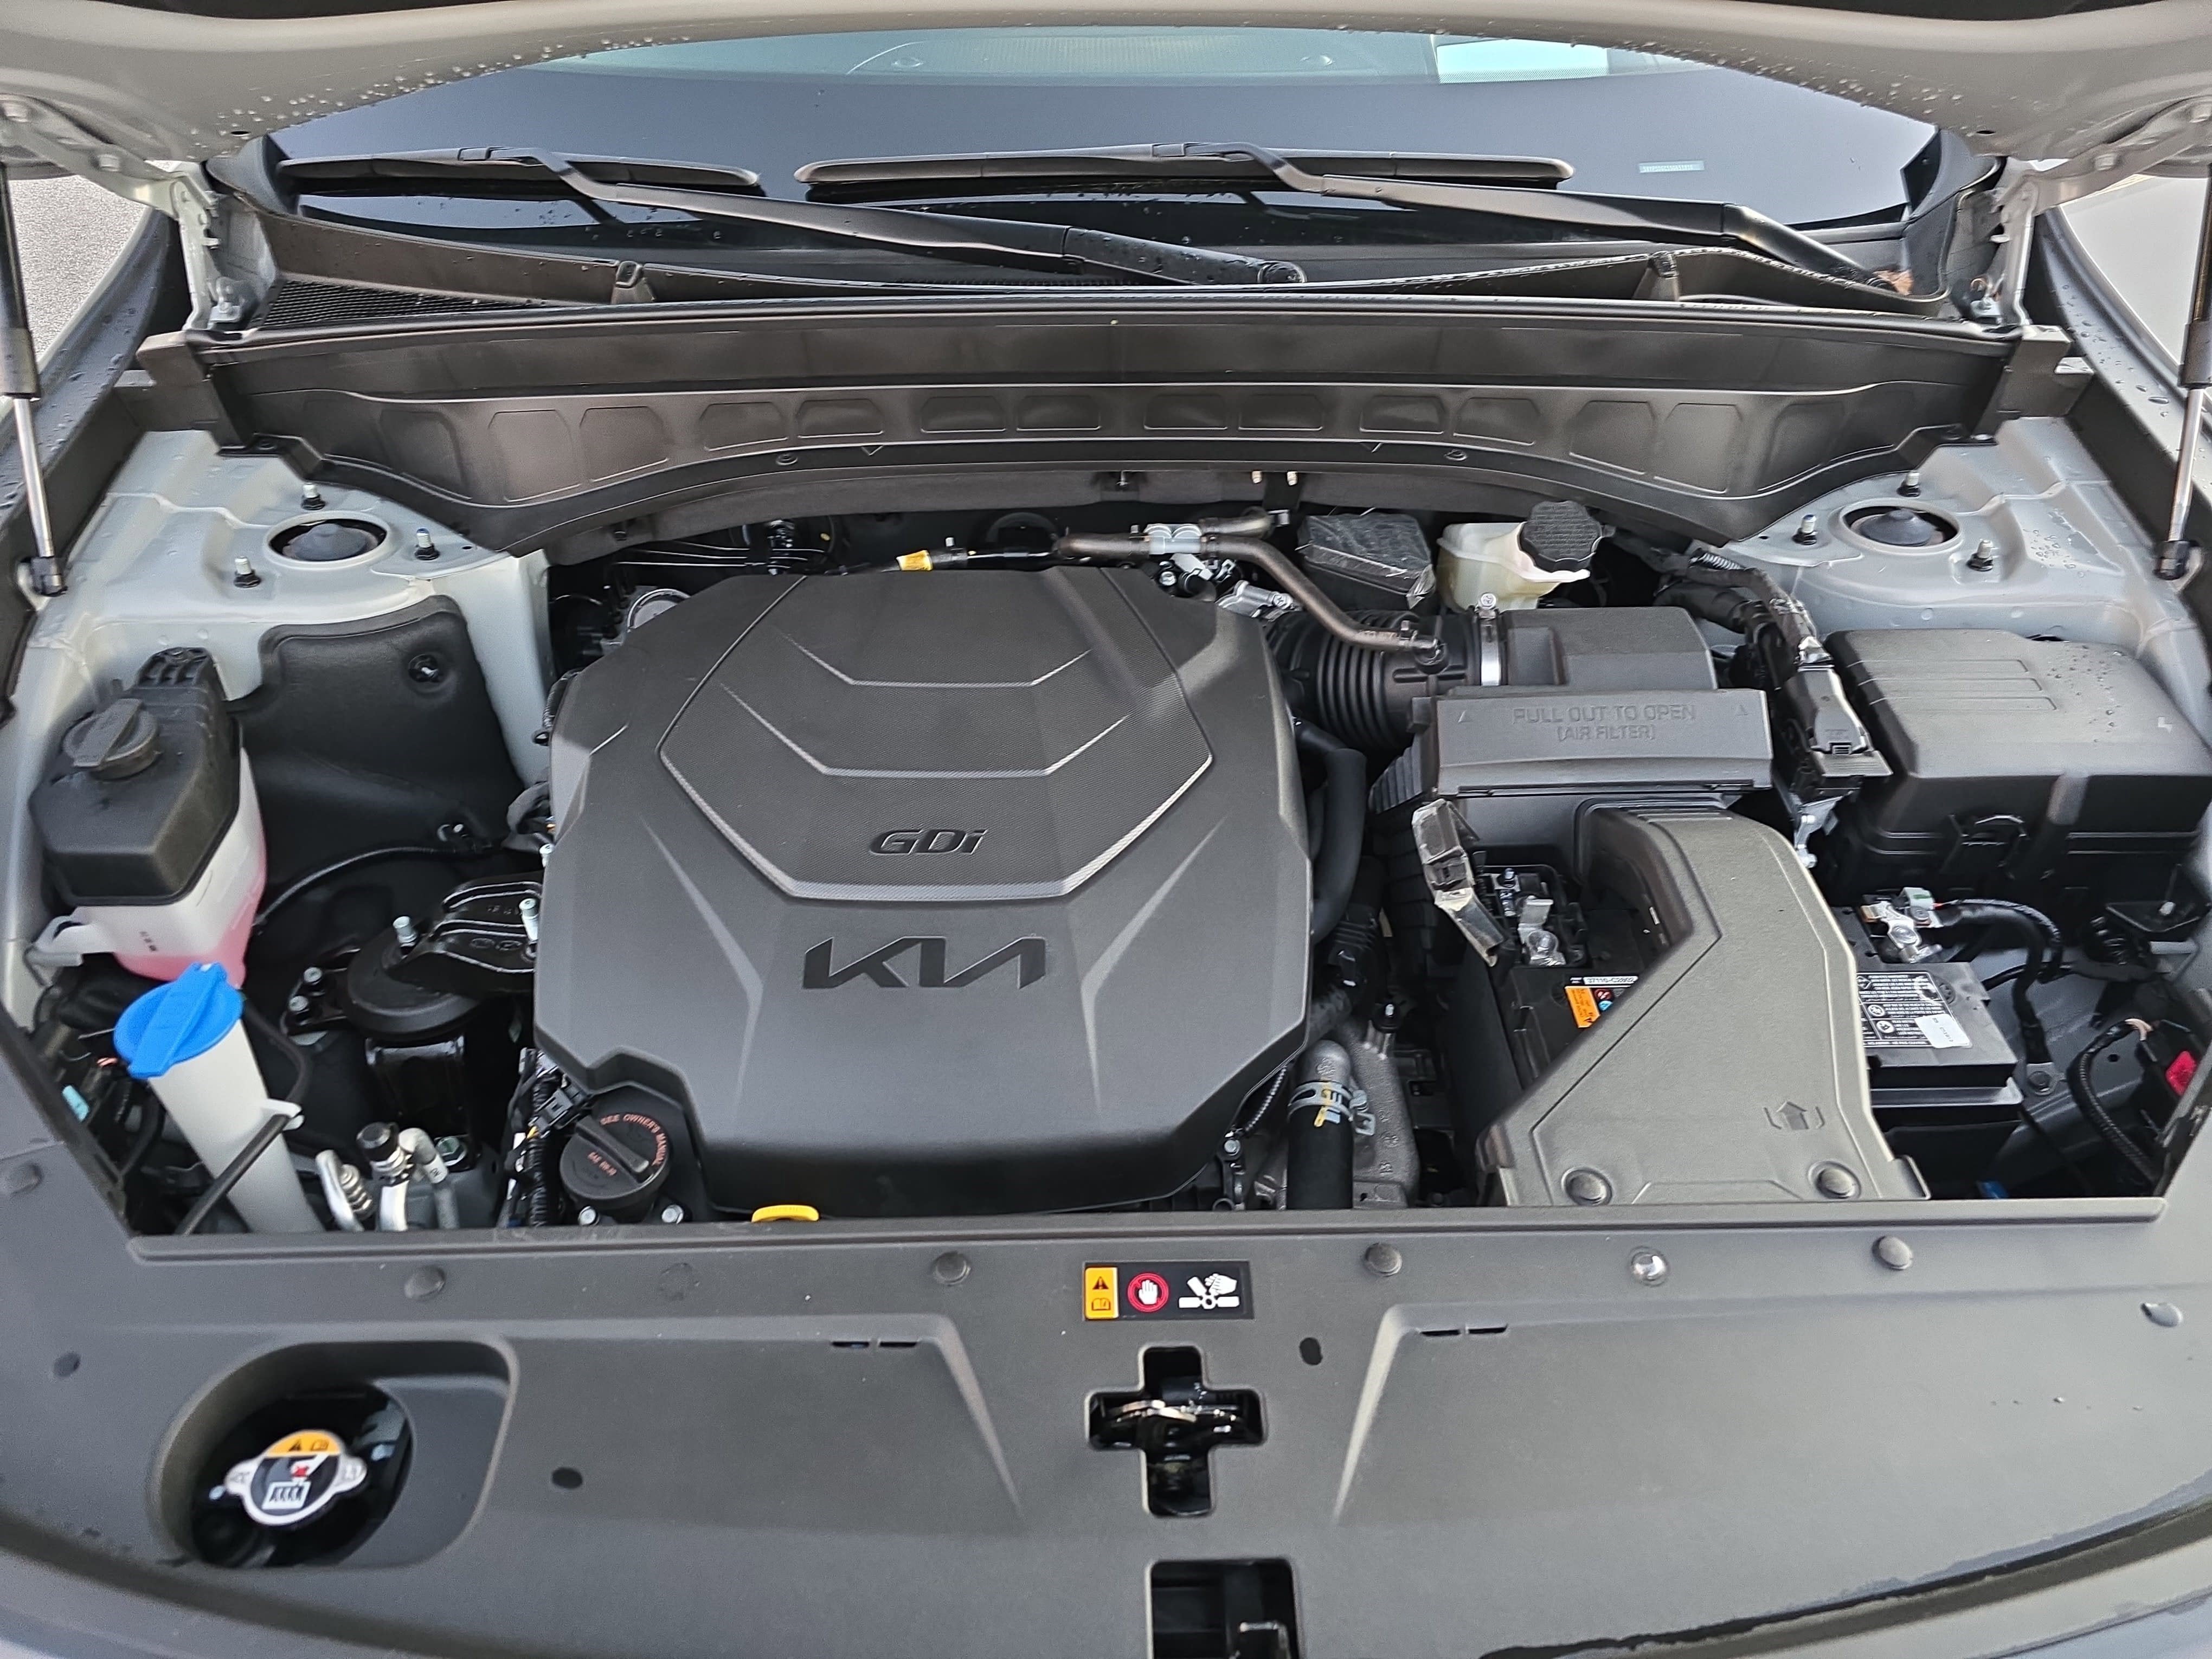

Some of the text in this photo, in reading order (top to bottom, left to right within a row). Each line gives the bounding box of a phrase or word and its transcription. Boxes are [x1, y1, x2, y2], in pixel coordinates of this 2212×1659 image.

[1513, 704, 1695, 723] PULL OUT TO OPEN
[871, 829, 988, 855] GDi
[803, 936, 1046, 989] KIA
[600, 1114, 620, 1125] SEE
